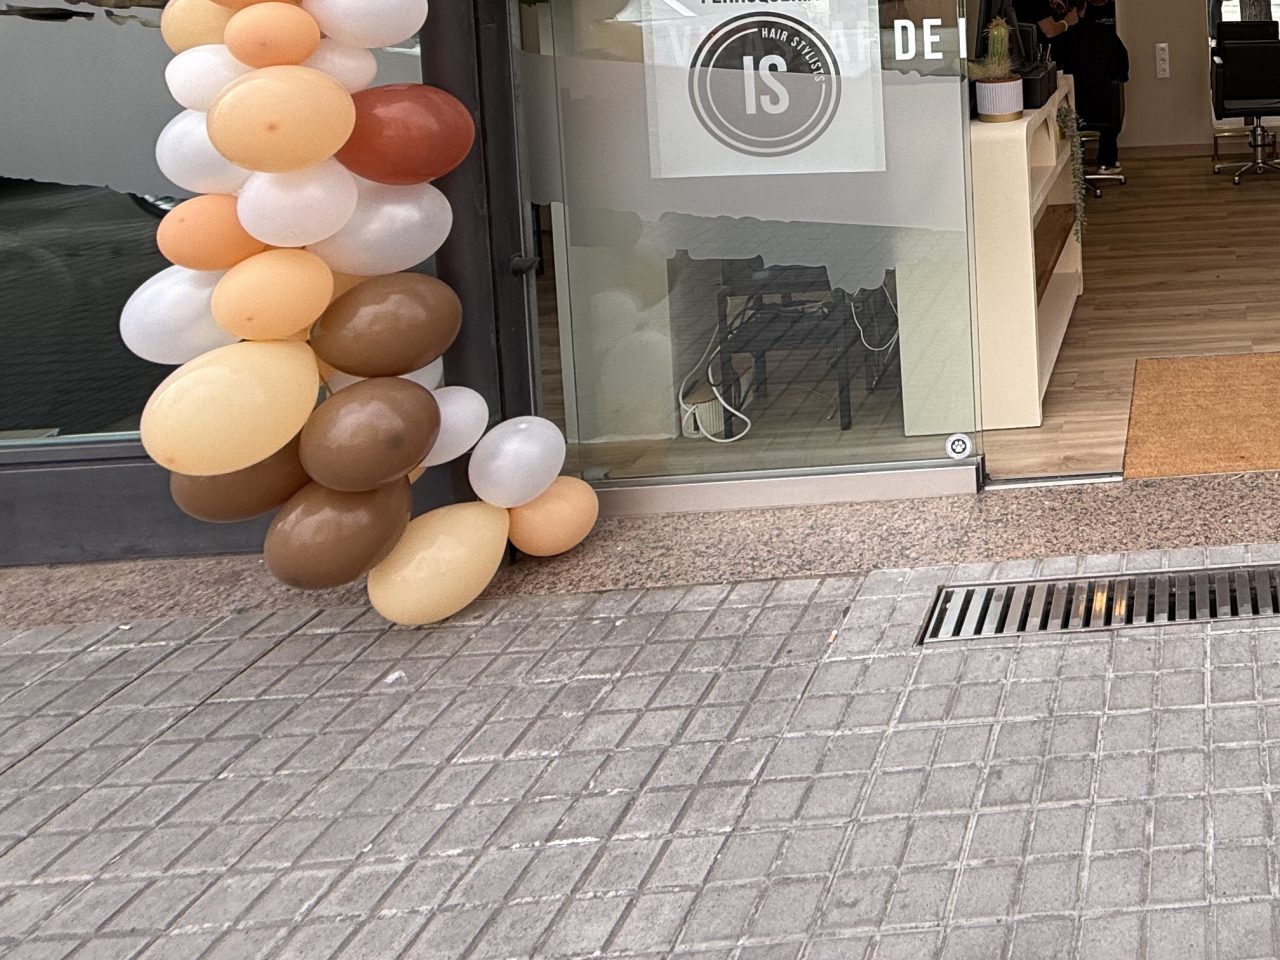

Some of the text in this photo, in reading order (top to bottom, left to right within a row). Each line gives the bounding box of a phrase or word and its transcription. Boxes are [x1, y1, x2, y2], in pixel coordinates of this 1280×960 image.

[761, 27, 788, 42] HAIR
[791, 37, 825, 82] STYLISTS
[894, 18, 943, 61] DE
[742, 54, 790, 115] IS
